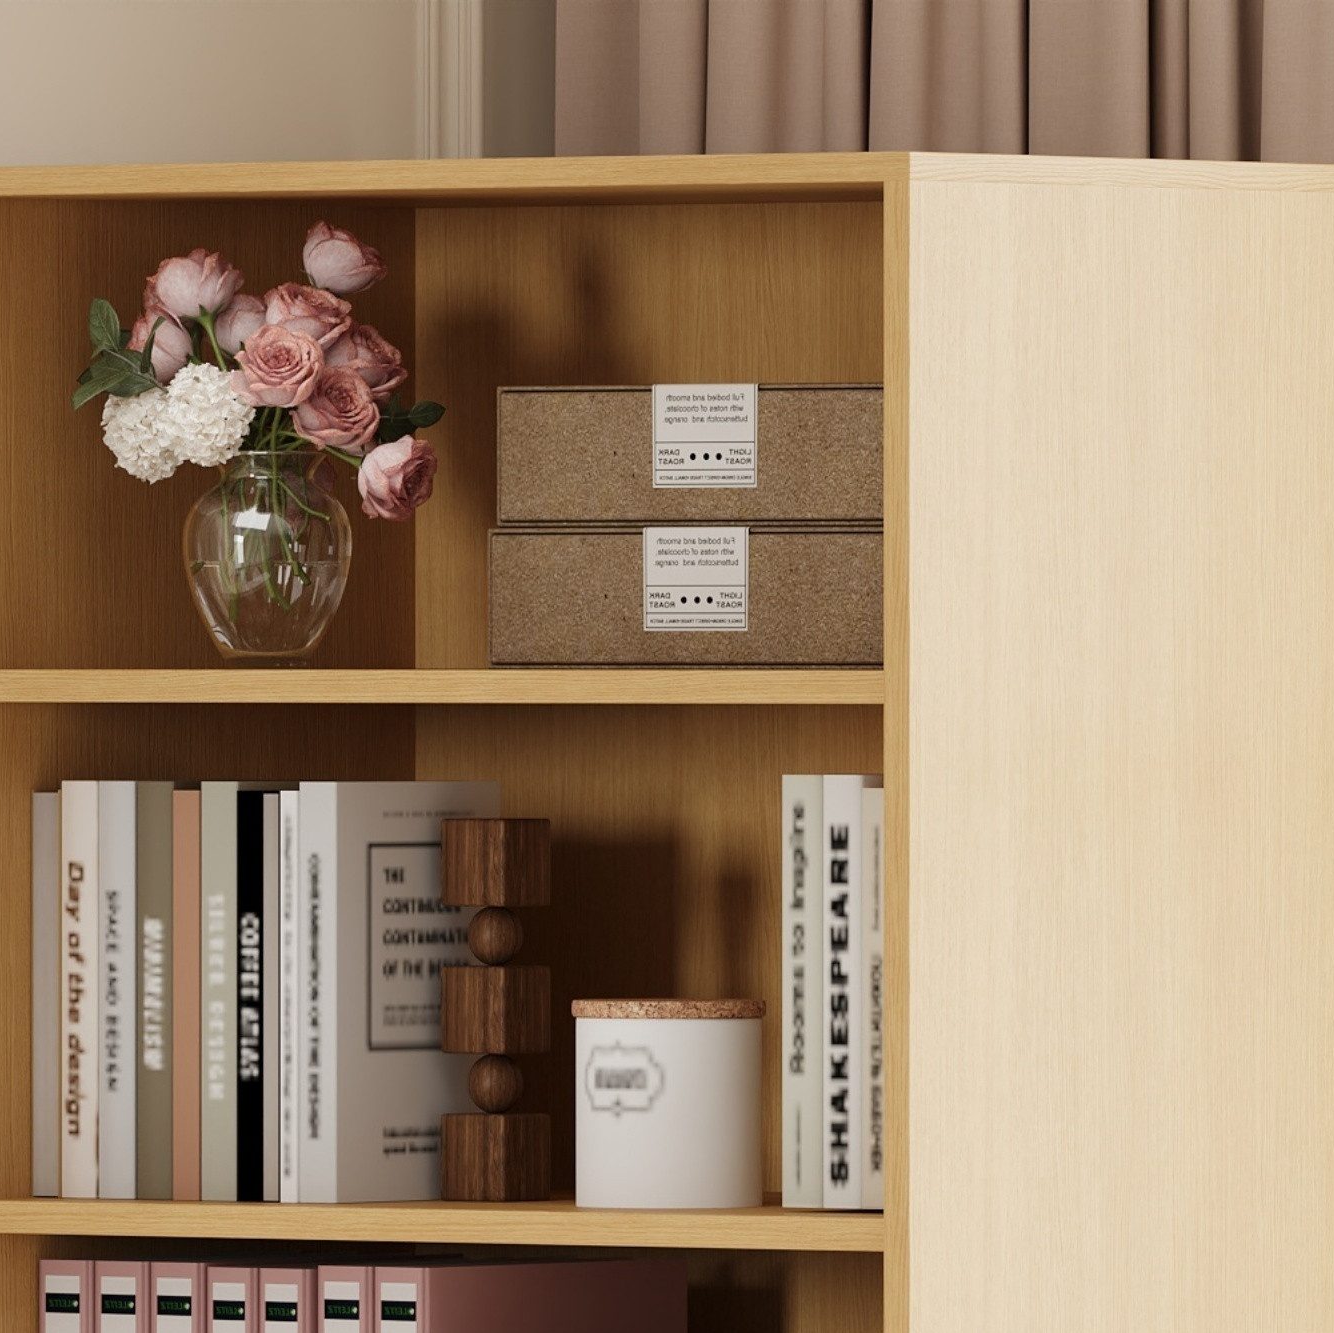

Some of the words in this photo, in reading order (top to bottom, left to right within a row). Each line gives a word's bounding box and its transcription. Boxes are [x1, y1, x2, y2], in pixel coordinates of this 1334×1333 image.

[65, 860, 86, 921] Day
[67, 932, 87, 965] of
[105, 889, 119, 954] SPACE
[790, 924, 805, 957] to
[67, 973, 86, 1023] the
[105, 961, 119, 1006] AND
[829, 824, 849, 1185] SHAKESPEARE
[789, 964, 805, 1076] Rooms
[65, 1033, 88, 1138] design
